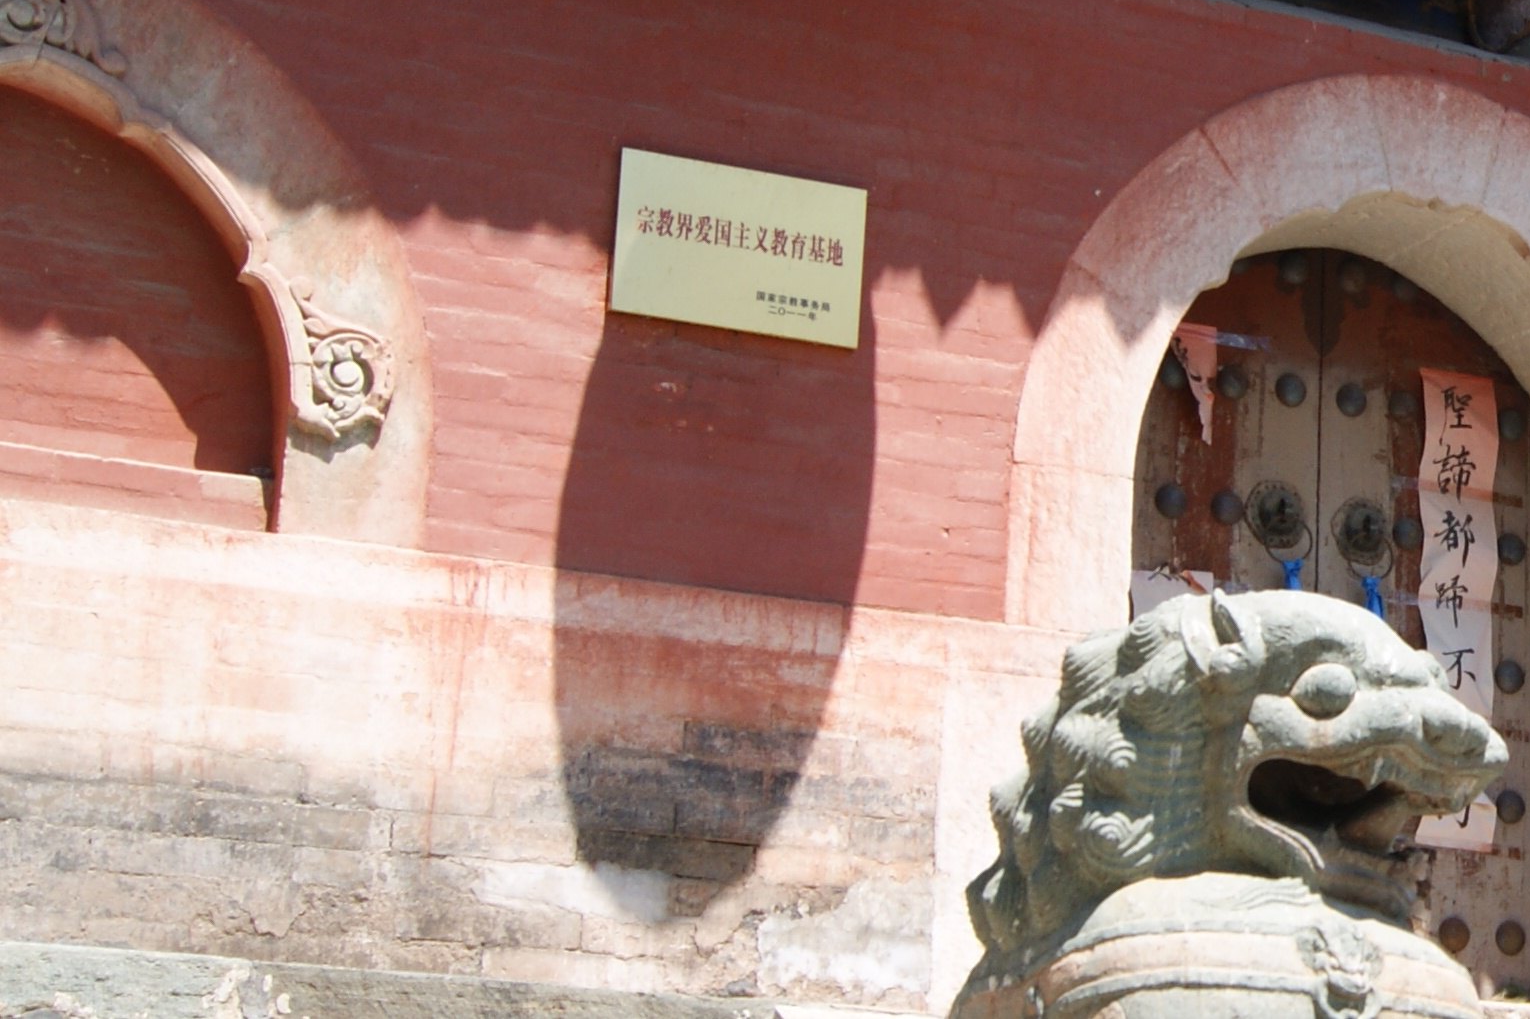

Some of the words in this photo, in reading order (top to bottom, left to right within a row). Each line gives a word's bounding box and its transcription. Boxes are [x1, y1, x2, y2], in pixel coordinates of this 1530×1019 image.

[637, 205, 844, 267] 宗教界爱国主义教育基地
[756, 290, 831, 313] 国家宗教事务局
